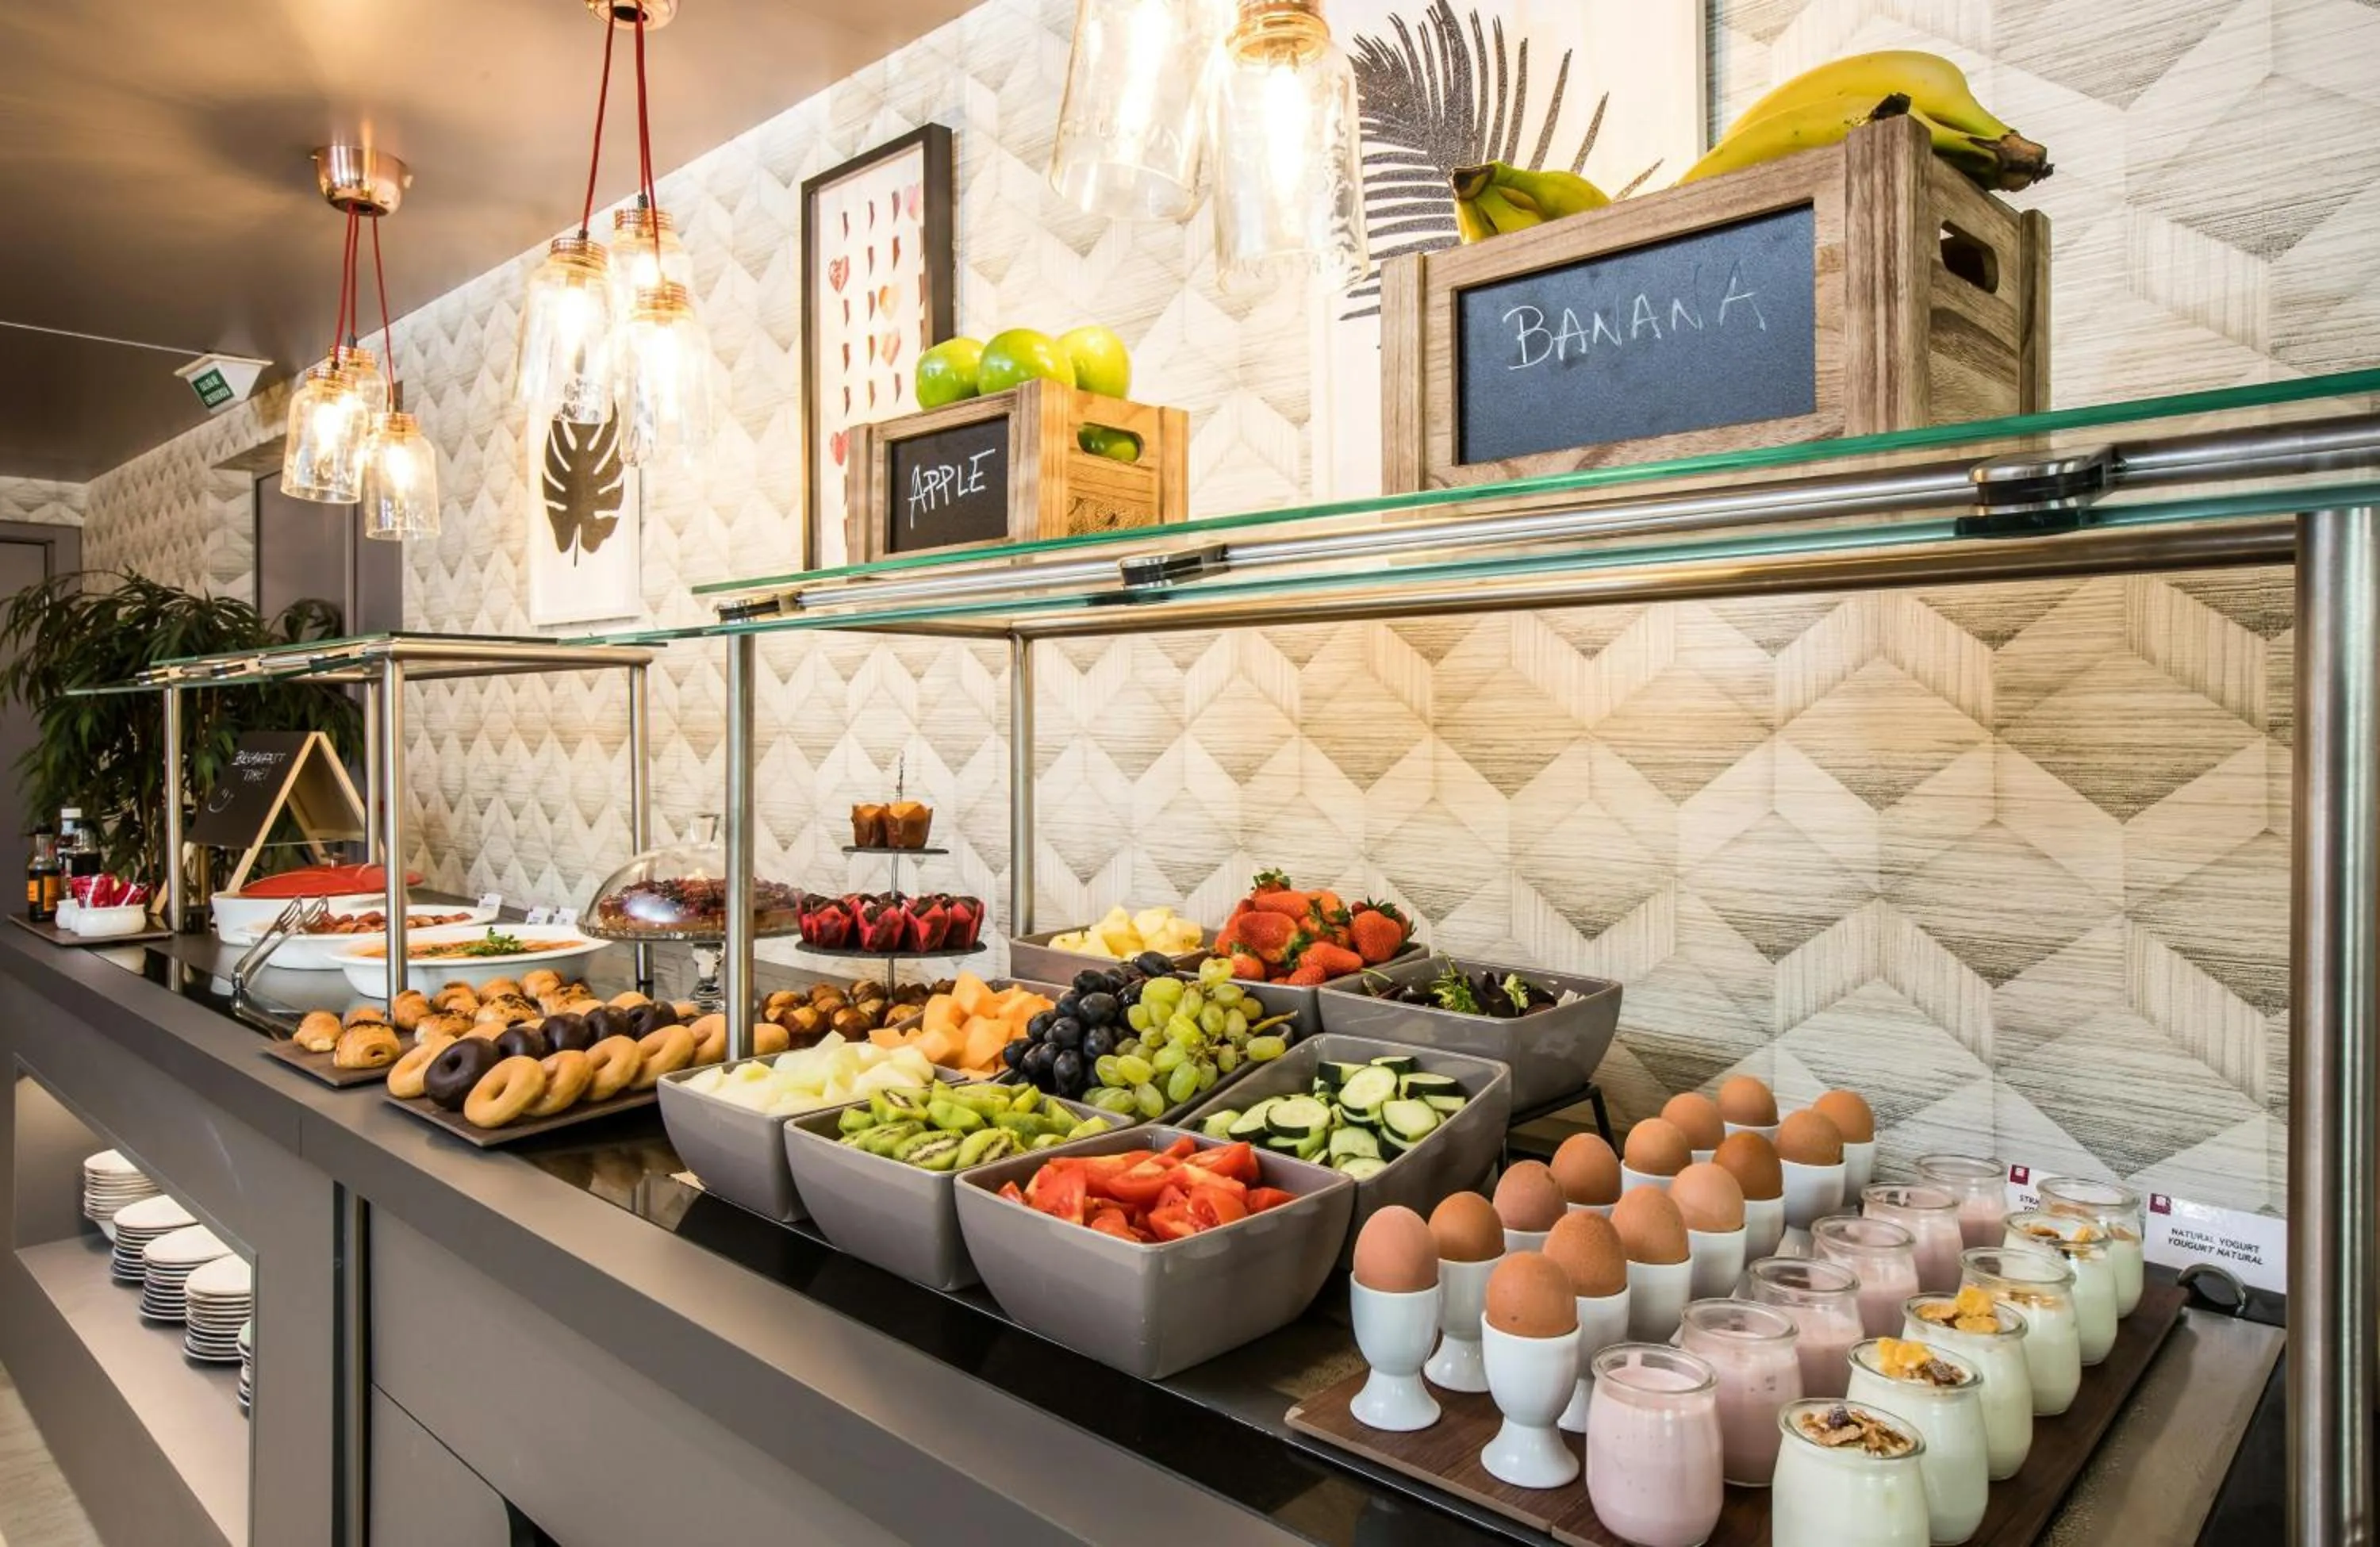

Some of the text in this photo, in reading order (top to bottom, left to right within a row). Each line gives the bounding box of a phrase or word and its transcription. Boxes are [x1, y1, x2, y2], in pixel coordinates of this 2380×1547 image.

[1503, 261, 1767, 370] BANANA
[908, 447, 996, 529] APPLE
[2171, 1227, 2260, 1253] NATURAL YOGURT
[2216, 1247, 2264, 1265] NATURAL
